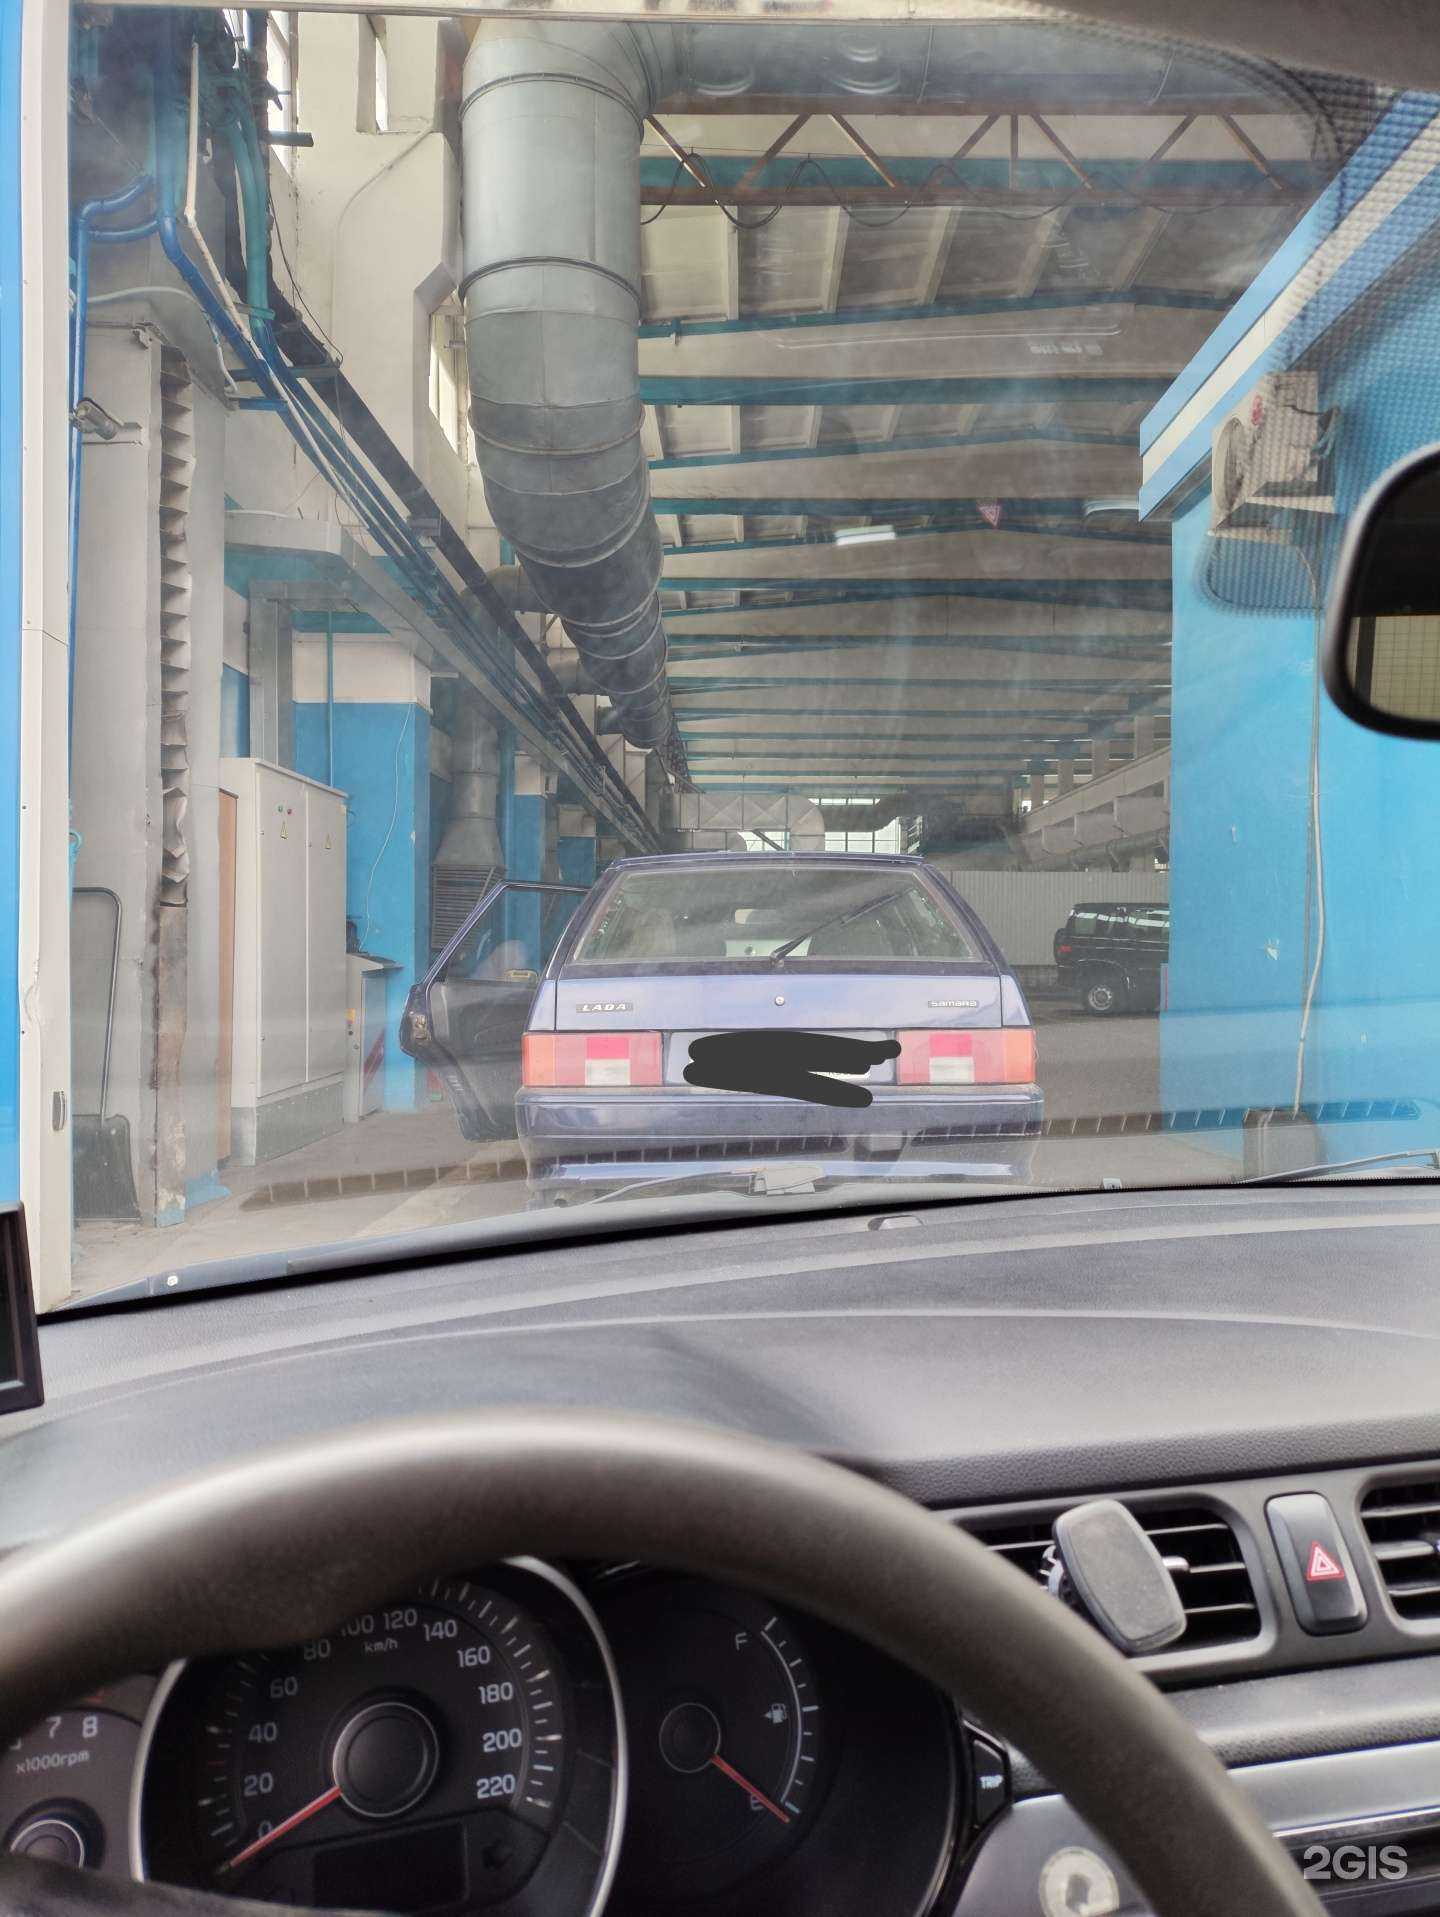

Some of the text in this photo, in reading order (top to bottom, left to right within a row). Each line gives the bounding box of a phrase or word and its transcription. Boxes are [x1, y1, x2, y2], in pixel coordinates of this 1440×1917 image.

[582, 1003, 626, 1012] LADA
[384, 1608, 417, 1630] 120
[424, 1619, 458, 1641] 140
[303, 1639, 331, 1660] 80
[364, 1637, 399, 1654] km/h
[734, 1632, 748, 1651] F
[457, 1645, 491, 1668] 160
[270, 1676, 299, 1699] 60
[478, 1681, 514, 1704] 180
[46, 1715, 62, 1739] 7
[82, 1715, 99, 1739] 8
[248, 1721, 278, 1744] 40
[482, 1728, 523, 1753] 200
[243, 1772, 274, 1797] 20
[476, 1774, 516, 1799] 220
